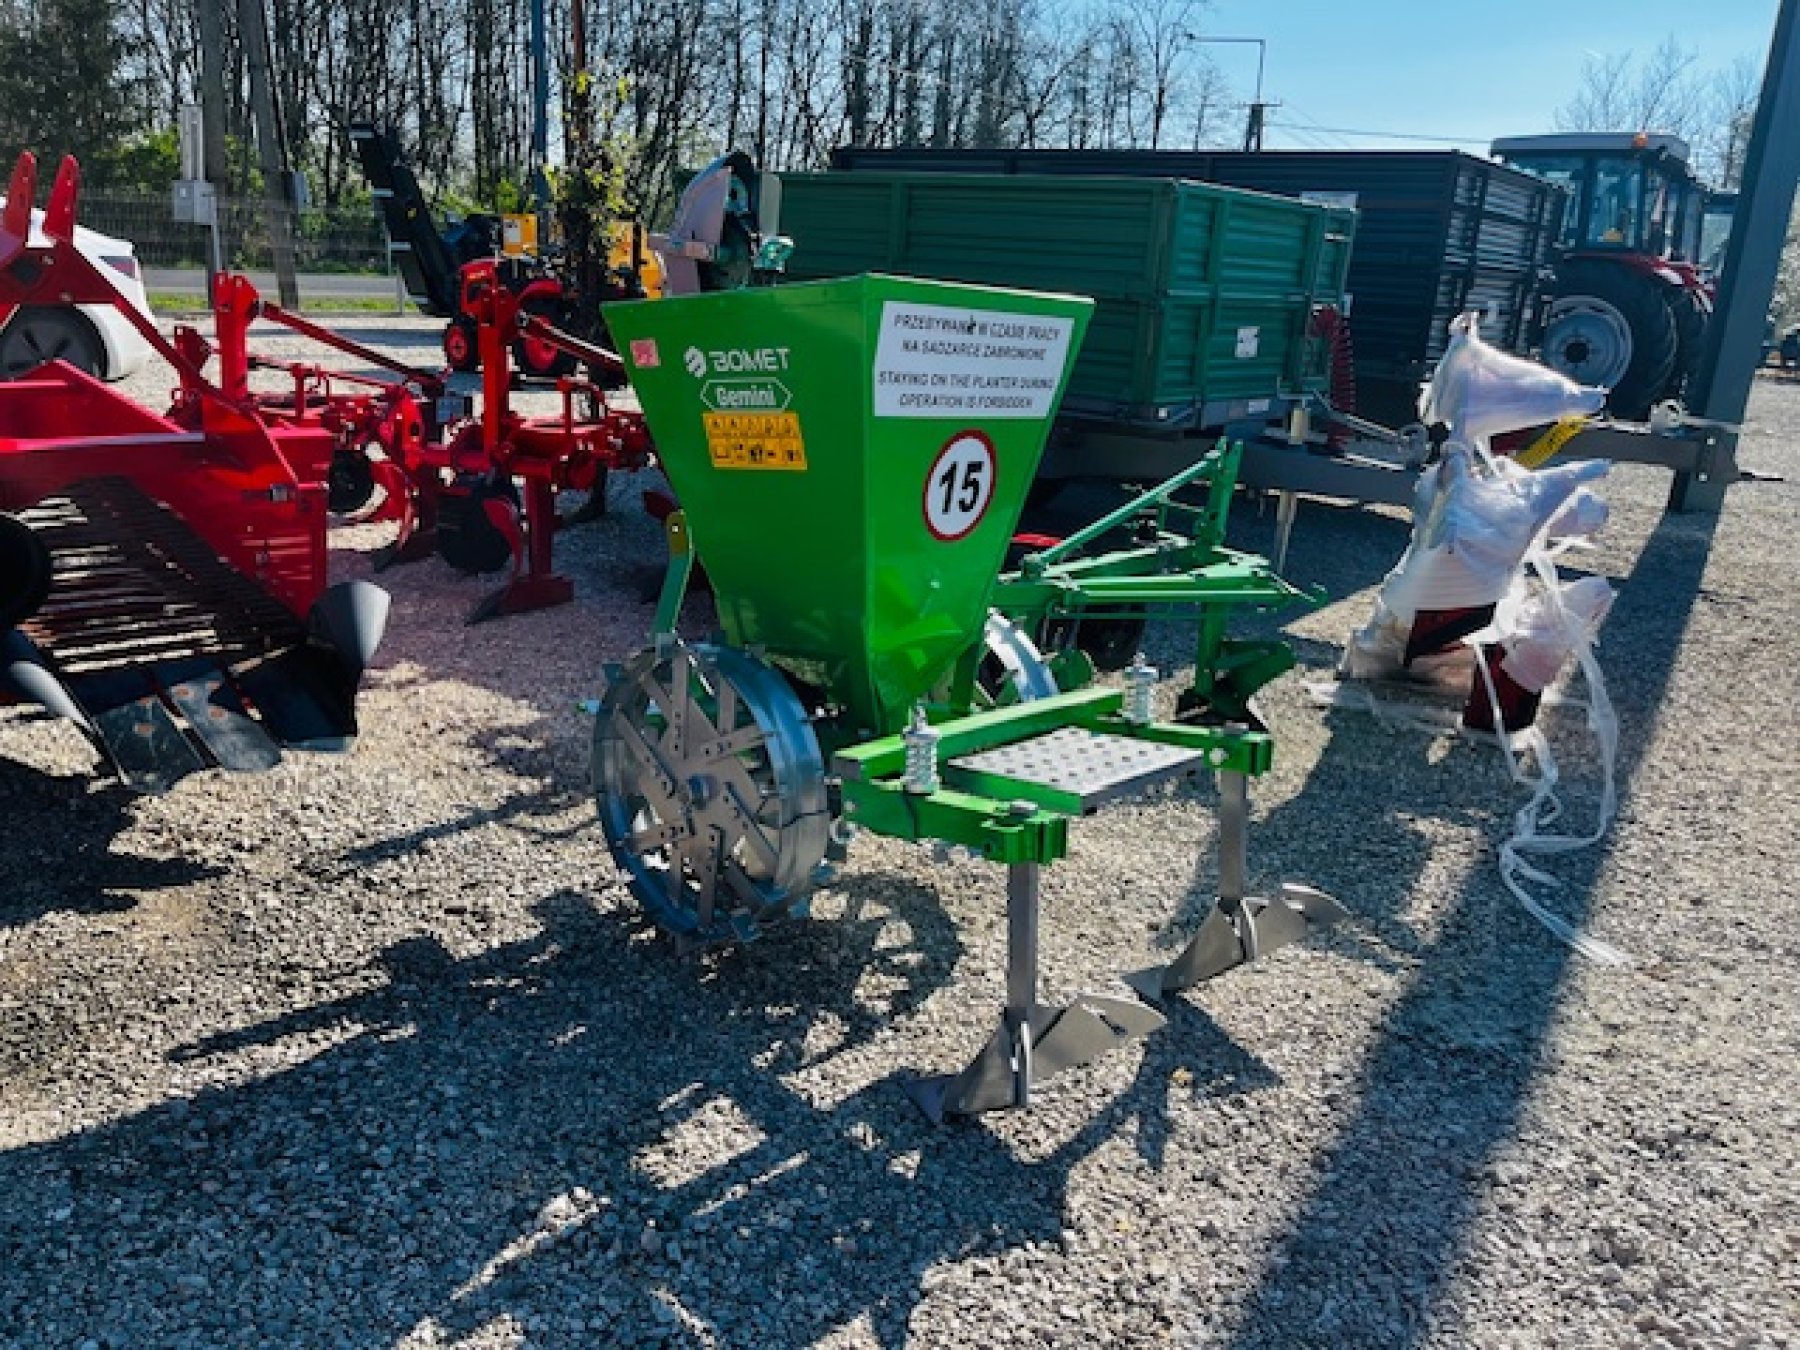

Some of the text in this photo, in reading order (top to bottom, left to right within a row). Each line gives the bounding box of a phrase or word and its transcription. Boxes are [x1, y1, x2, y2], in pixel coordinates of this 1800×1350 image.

[1027, 326, 1061, 340] PRACY
[902, 340, 918, 352] NA
[708, 347, 790, 372] BOMET
[879, 370, 1054, 389] STAYING ON THE PLANTER DURING
[714, 384, 776, 406] Gemini
[899, 393, 1033, 408] OPERATION IS FORBIDDEN
[938, 460, 984, 515] 15
